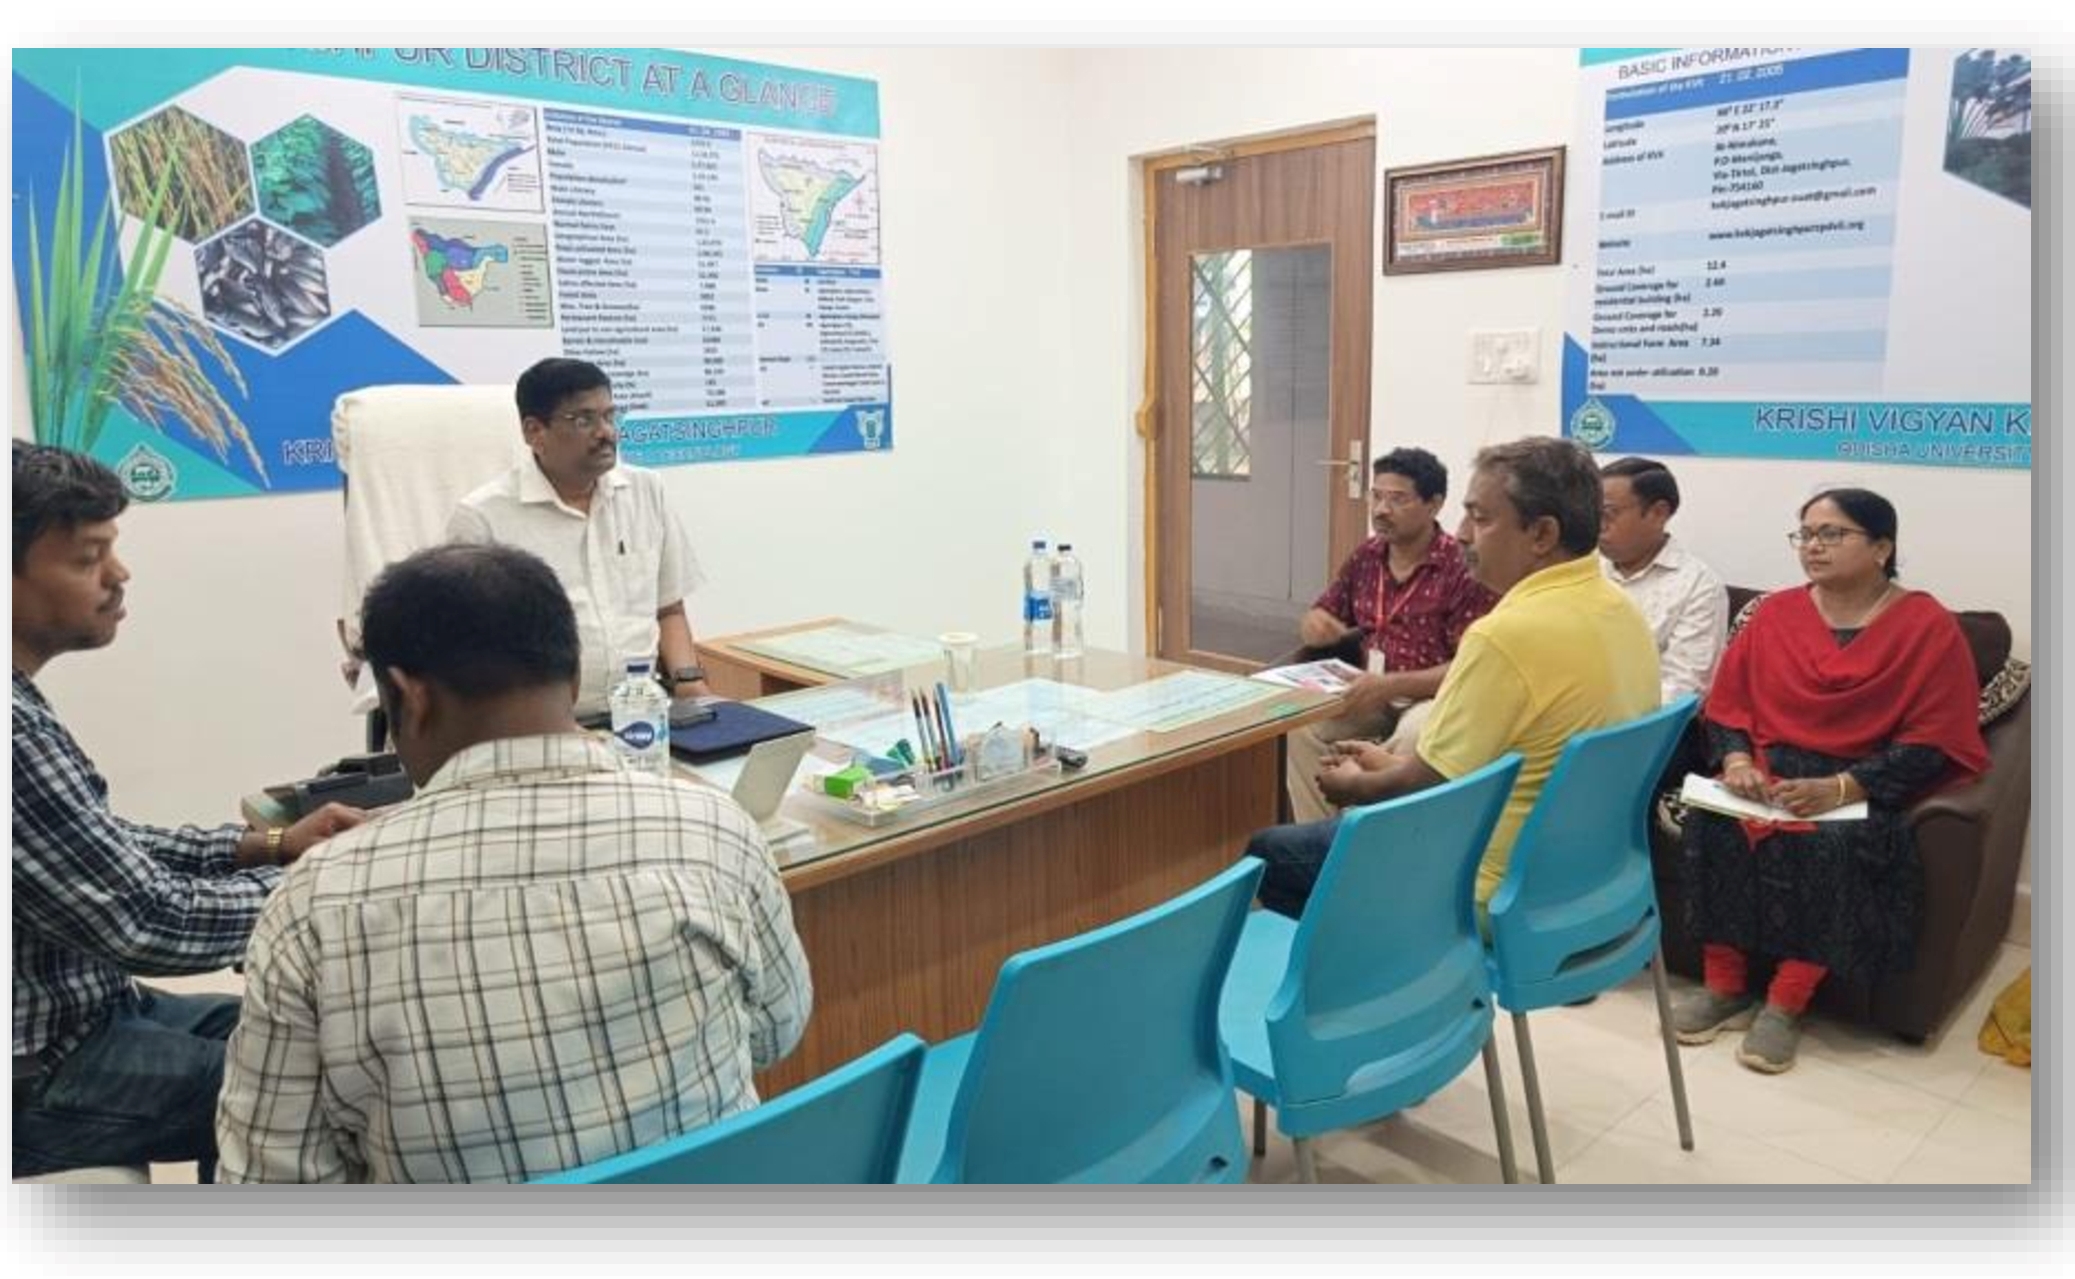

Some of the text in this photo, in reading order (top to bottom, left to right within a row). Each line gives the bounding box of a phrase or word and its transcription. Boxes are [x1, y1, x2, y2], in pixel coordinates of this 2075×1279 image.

[1618, 48, 1794, 80] BASIC INFORMAT
[466, 48, 631, 90] DISTRICT
[642, 62, 682, 97] AT
[691, 69, 710, 99] A
[719, 72, 839, 117] GLANCE
[618, 417, 778, 443] AGATSINGHPUR
[1754, 406, 2031, 435] KRISHI VIGYAN K
[282, 439, 334, 465] KRI
[1838, 441, 1910, 457] ODISHA
